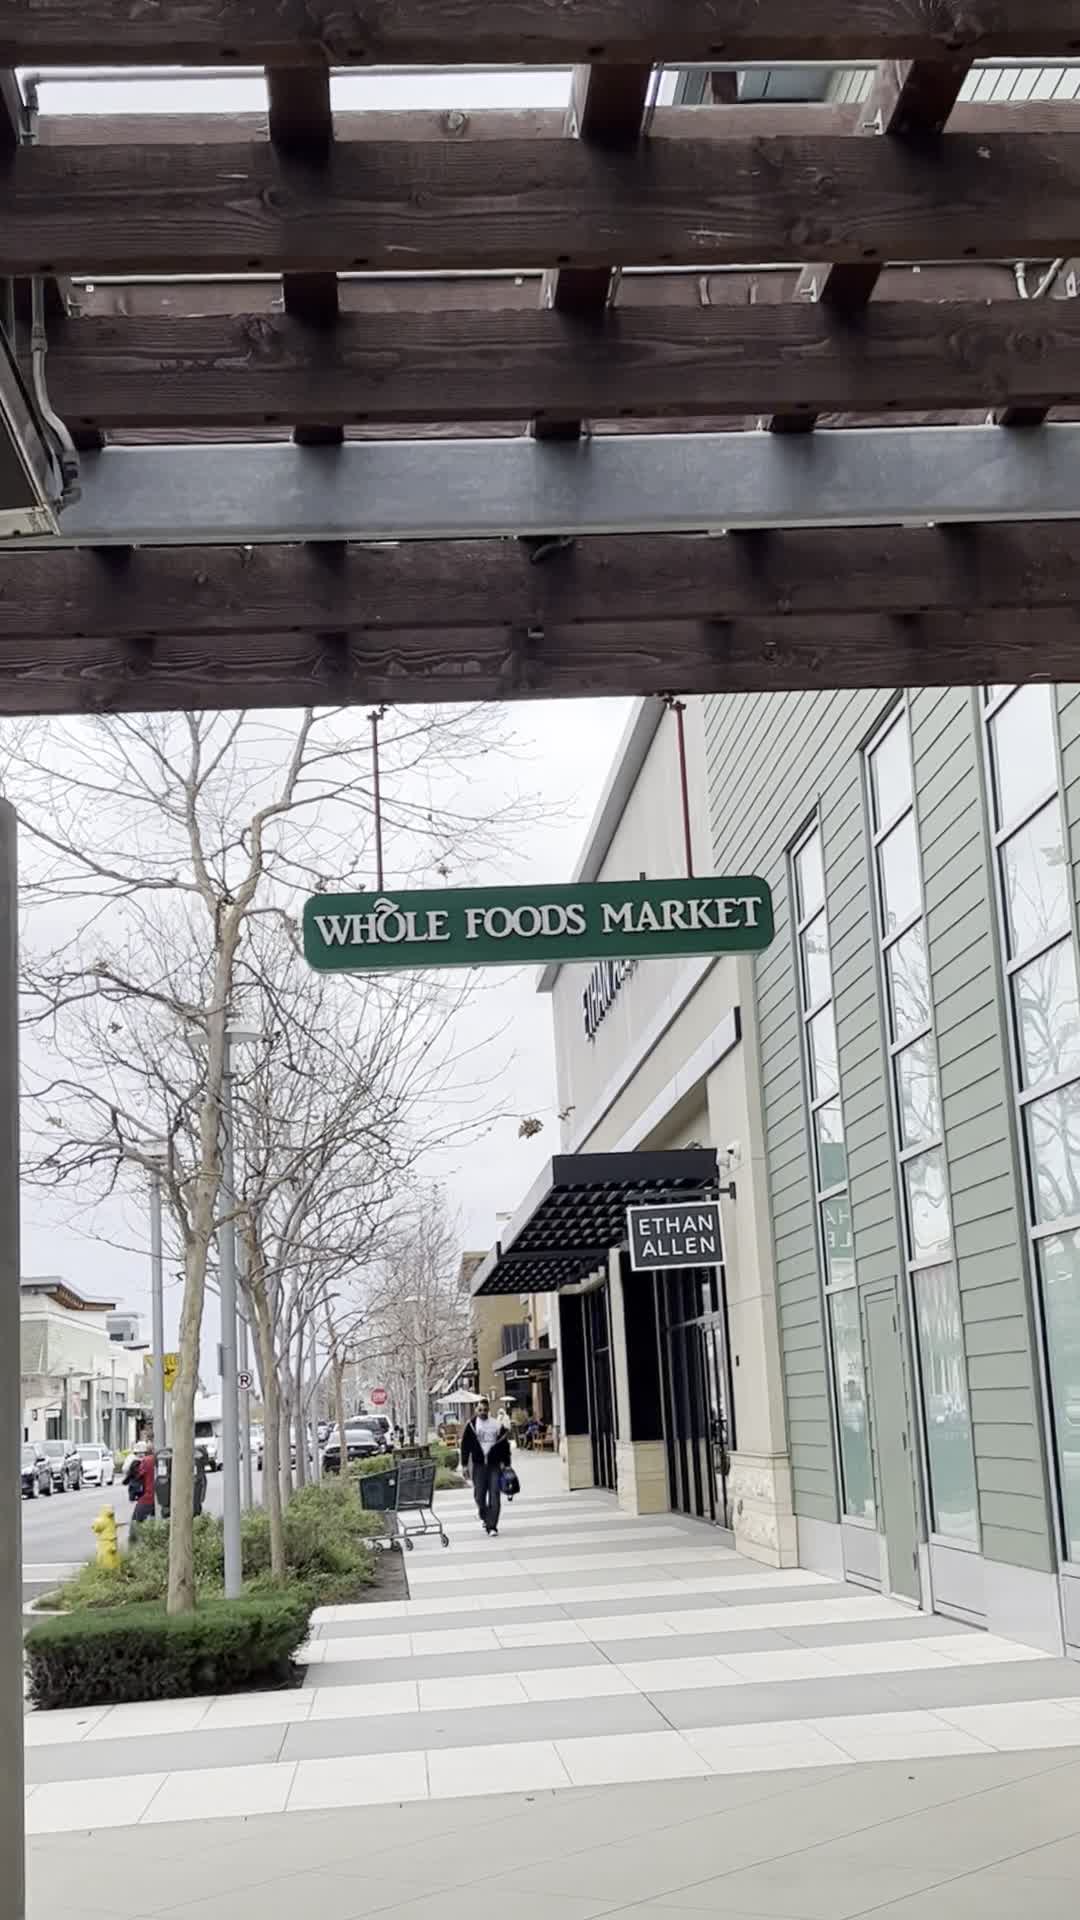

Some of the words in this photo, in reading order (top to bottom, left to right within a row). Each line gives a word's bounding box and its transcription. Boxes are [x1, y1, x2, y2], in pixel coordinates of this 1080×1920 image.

[313, 897, 450, 946] WHOLE
[464, 904, 586, 939] FOODS
[600, 897, 762, 933] MARKET
[639, 1214, 714, 1236] ETHAN
[641, 1235, 716, 1258] ALLEN
[240, 1375, 249, 1386] R
